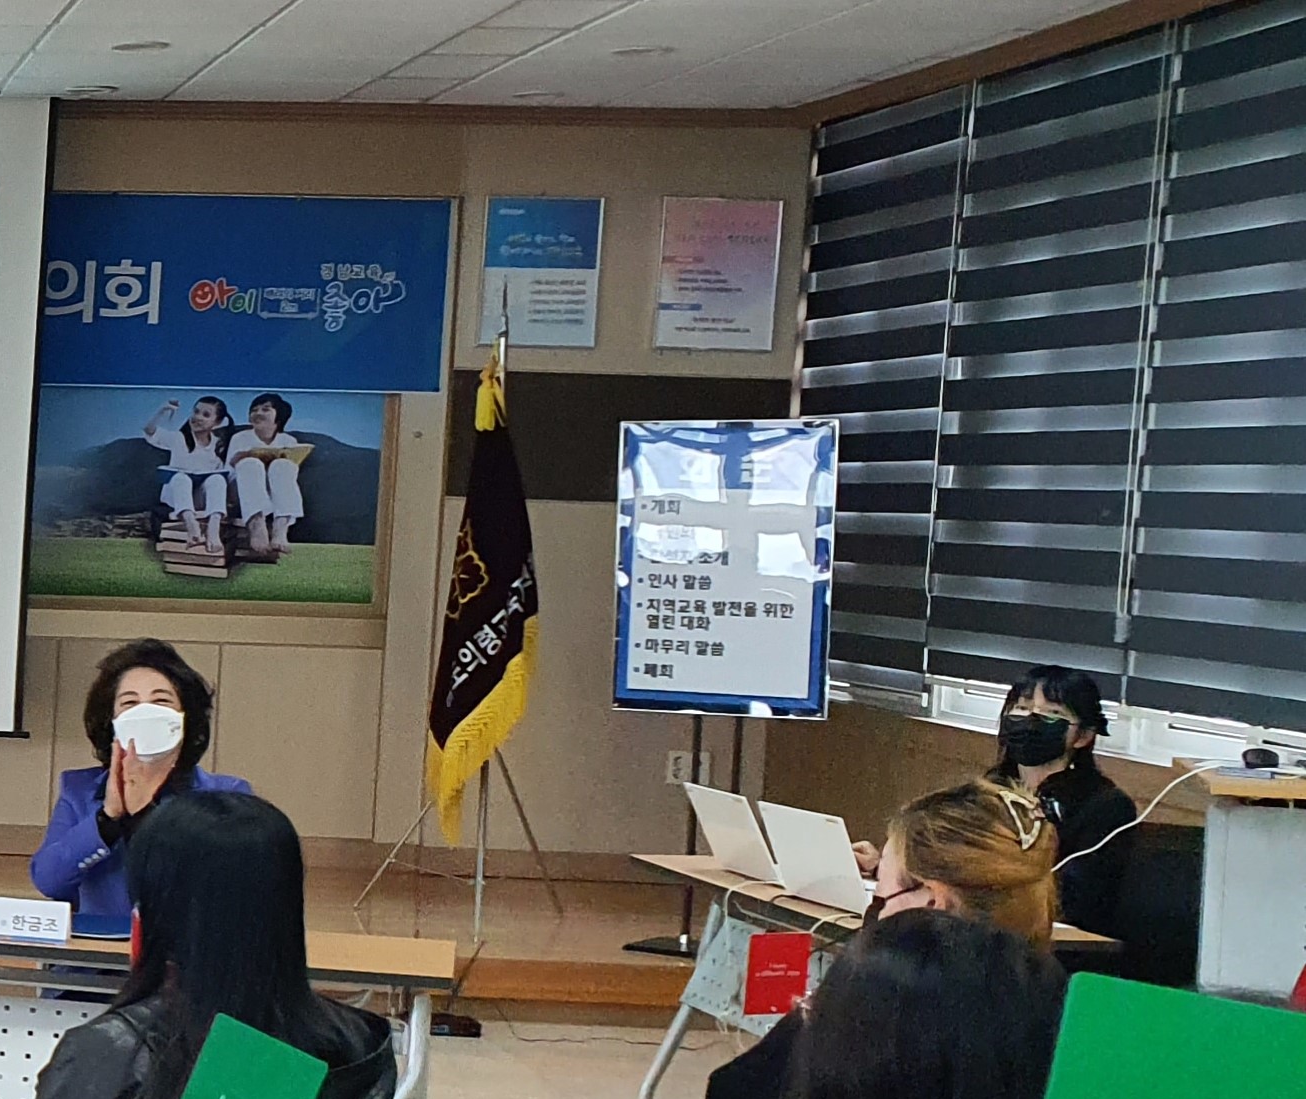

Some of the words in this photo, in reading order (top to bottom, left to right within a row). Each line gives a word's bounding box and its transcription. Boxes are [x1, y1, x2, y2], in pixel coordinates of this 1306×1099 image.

[44, 260, 162, 324] 의회
[651, 500, 681, 515] 개회
[698, 551, 729, 565] 소개
[648, 573, 677, 589] 인사
[682, 574, 712, 590] 말씀
[646, 598, 707, 614] 지역교육
[712, 601, 757, 616] 발전을
[762, 603, 794, 618] 위한
[646, 614, 675, 630] 열린
[680, 616, 711, 630] 대화
[644, 638, 690, 654] 마무리
[695, 641, 725, 656] 말씀
[643, 663, 674, 678] 폐회
[12, 914, 59, 932] 한금조
